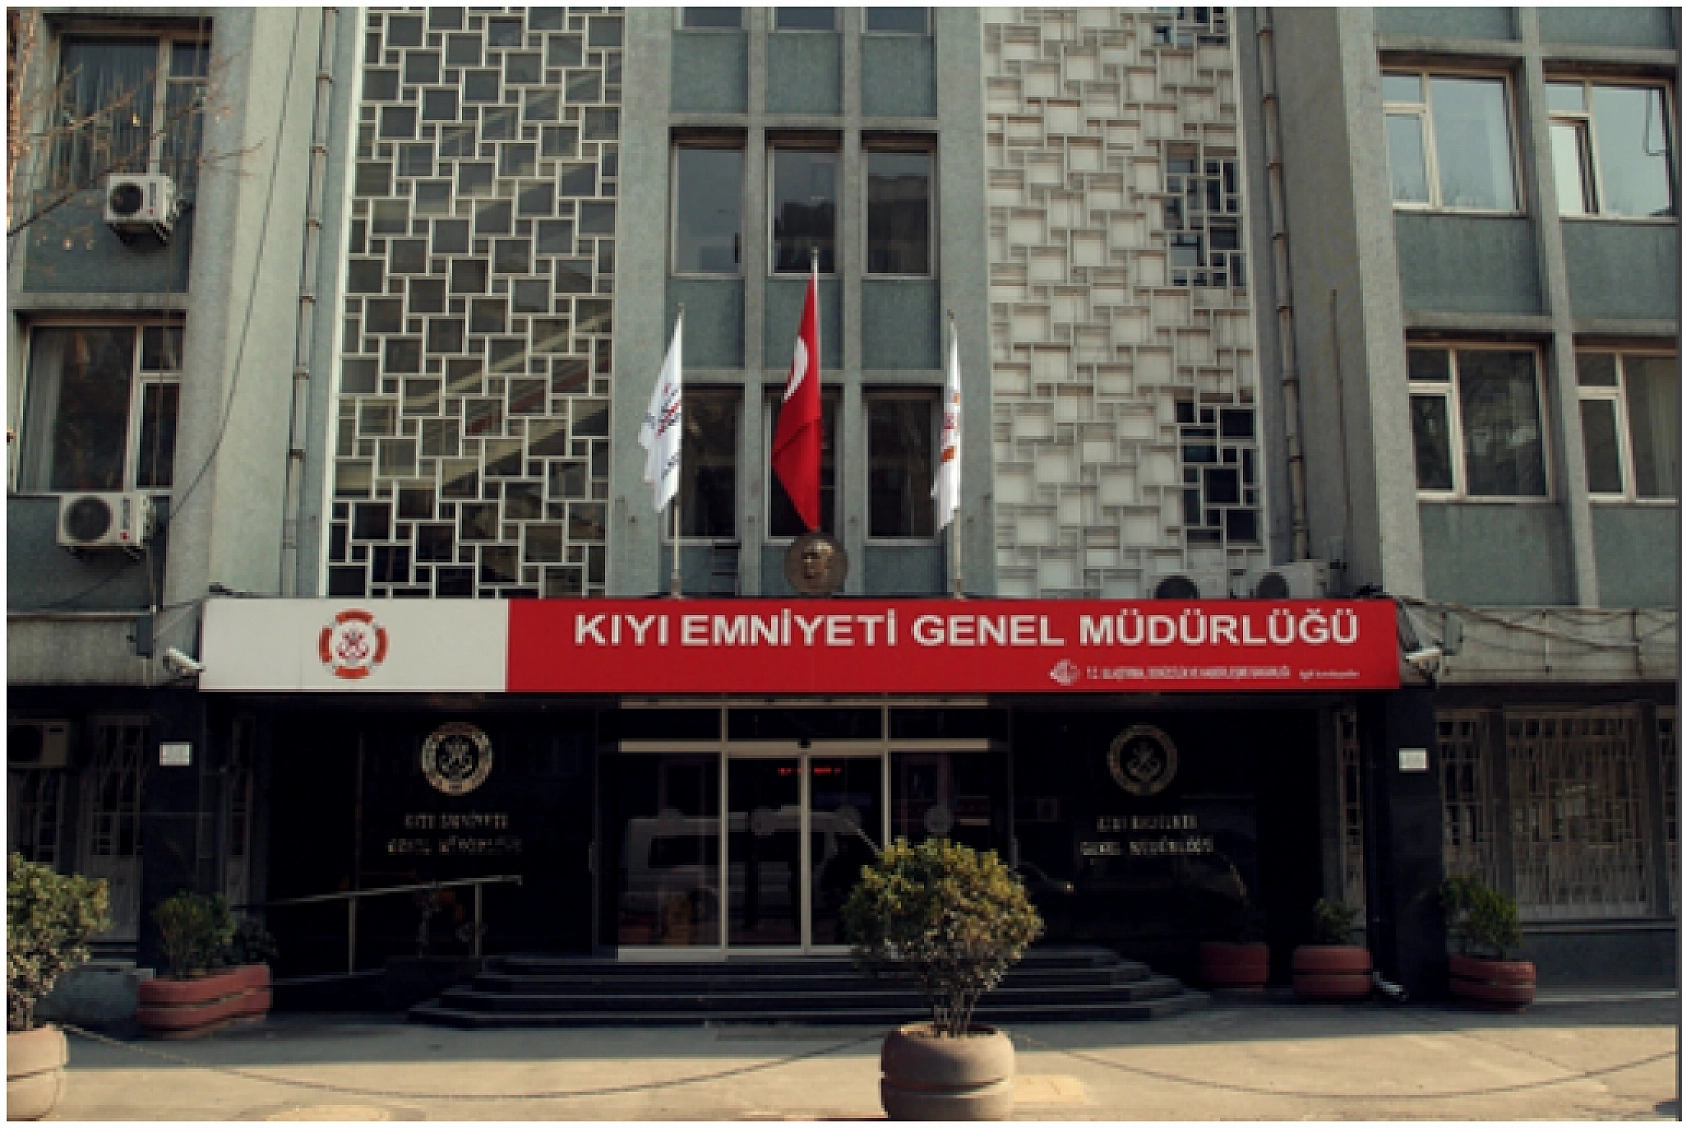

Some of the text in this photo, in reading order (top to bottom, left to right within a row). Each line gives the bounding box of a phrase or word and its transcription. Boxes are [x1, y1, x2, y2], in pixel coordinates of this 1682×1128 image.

[575, 607, 1359, 647] KIYI EMNİYETİ GENEL MÜDÜRLÜĞÜ
